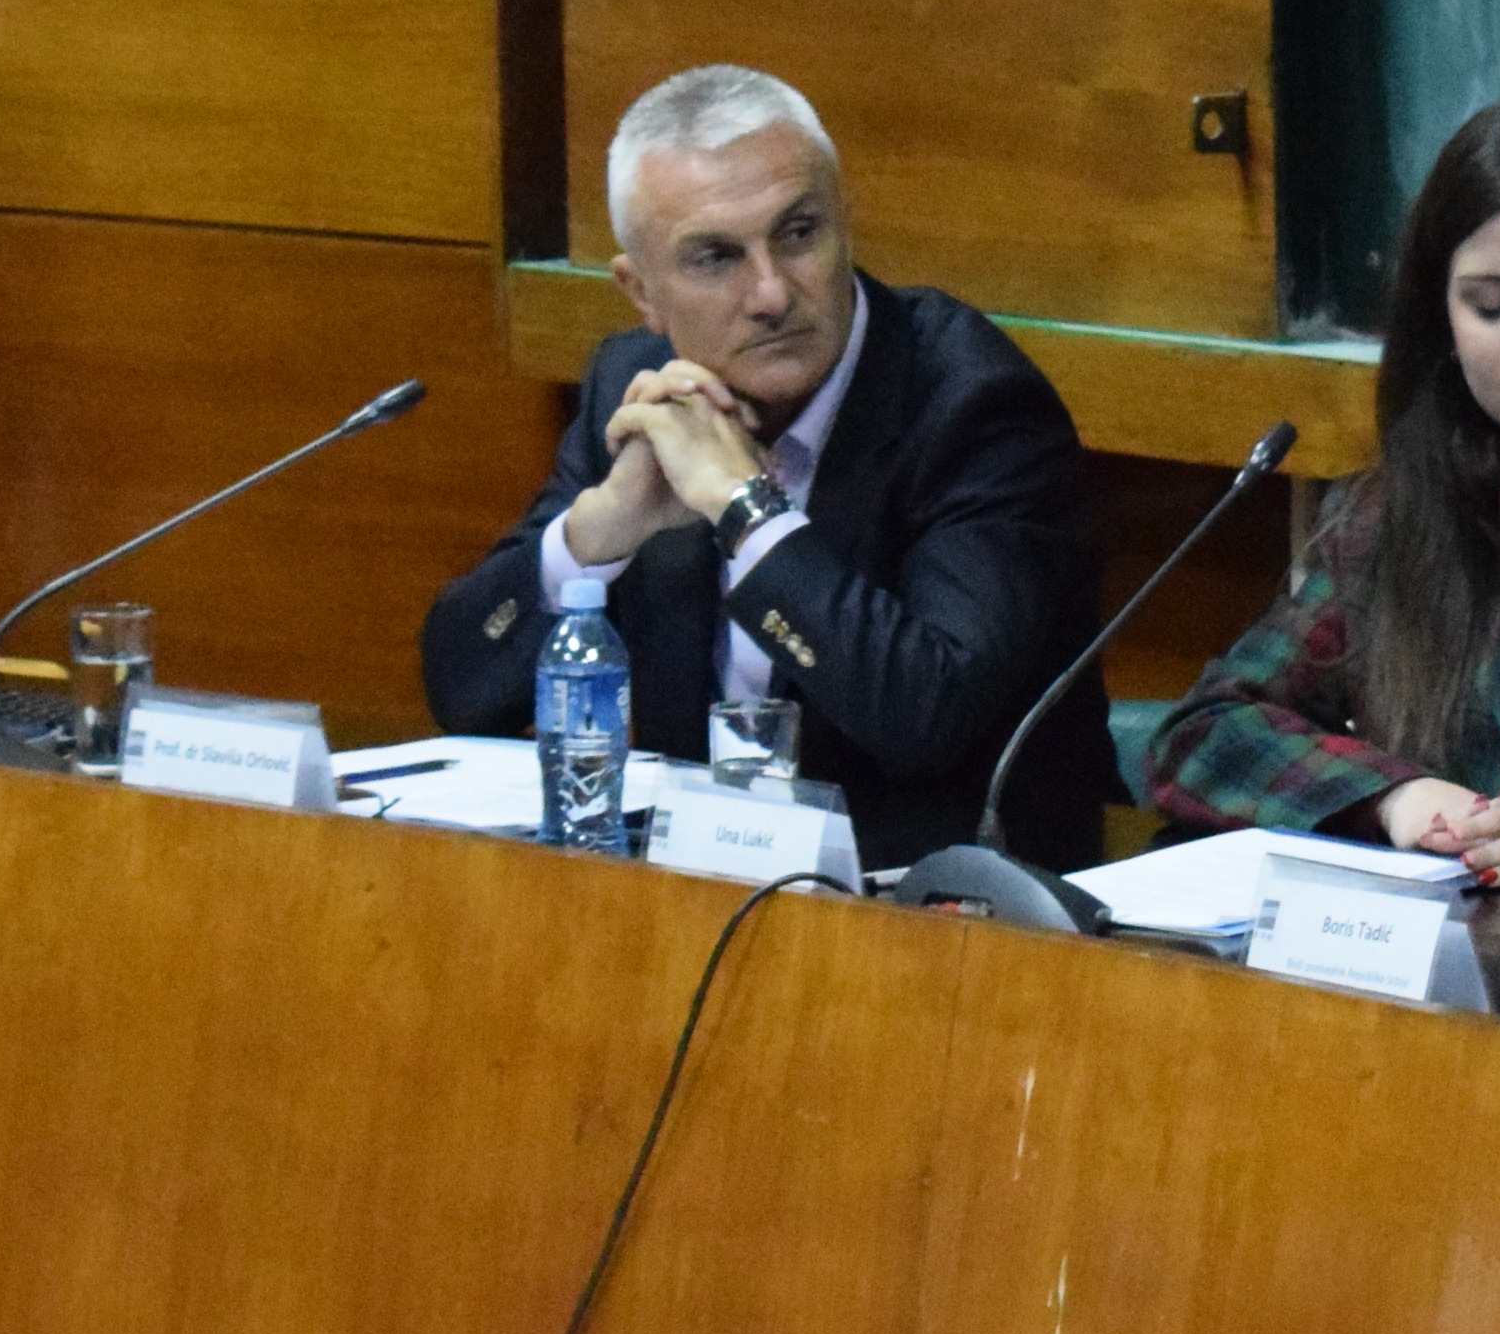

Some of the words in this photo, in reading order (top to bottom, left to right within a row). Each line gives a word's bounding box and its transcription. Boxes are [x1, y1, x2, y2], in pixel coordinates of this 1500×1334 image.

[716, 825, 740, 845] Una
[742, 828, 775, 849] Lukić
[1321, 916, 1355, 938] Boris
[1357, 920, 1394, 943] Tadić
